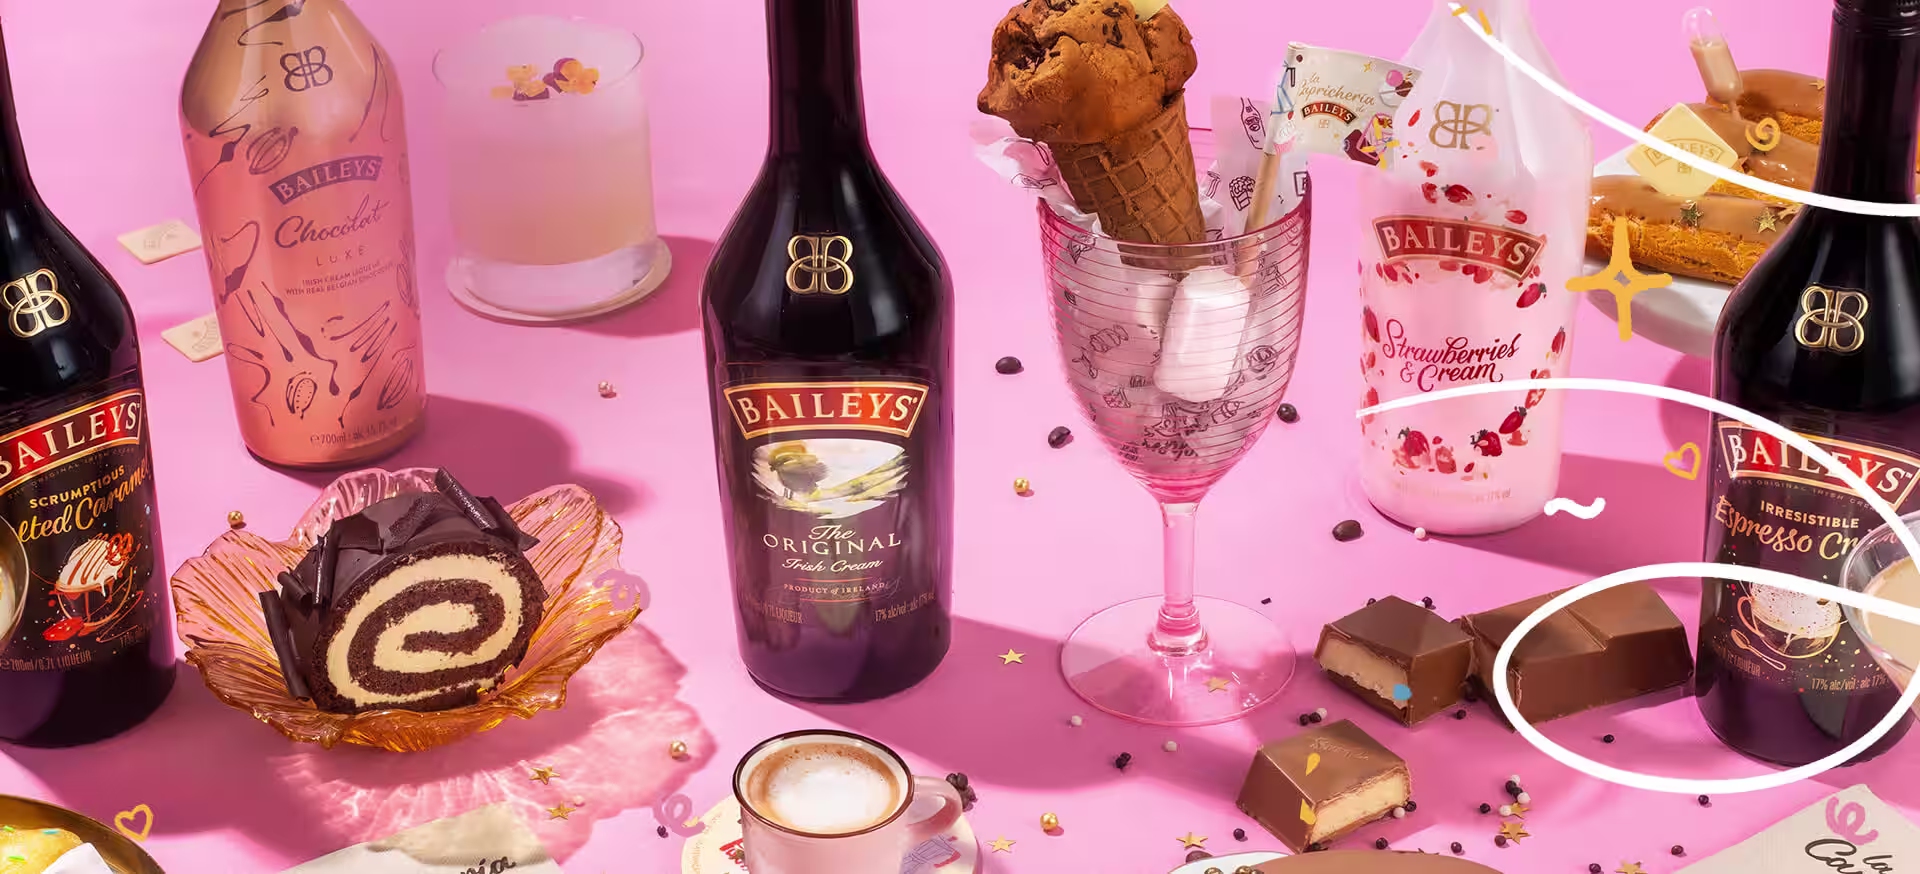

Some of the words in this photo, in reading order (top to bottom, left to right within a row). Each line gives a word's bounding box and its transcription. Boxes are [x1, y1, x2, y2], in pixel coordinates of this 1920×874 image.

[1303, 103, 1353, 121] BAILEYS
[275, 158, 381, 200] BAILEYS
[274, 194, 390, 249] Chocolat
[316, 245, 367, 267] LUXE
[1382, 224, 1531, 266] BAILEYS
[1383, 318, 1523, 365] Strawberries
[1400, 361, 1415, 383] &
[1417, 362, 1504, 392] Cream
[737, 391, 918, 425] BAILEYS
[29, 464, 125, 509] SCRUMPTIOUS
[1756, 480, 1807, 492] ORIGINAL
[1714, 494, 1813, 553] Espresso
[1760, 500, 1860, 529] IRRESISTIBLE
[763, 533, 902, 555] ORIGINAL
[808, 524, 857, 540] The
[782, 558, 826, 573] Irish
[830, 558, 885, 573] Cream
[784, 583, 828, 595] PRODUCT
[841, 582, 886, 594] IRELAND
[1811, 677, 1828, 691] 17%
